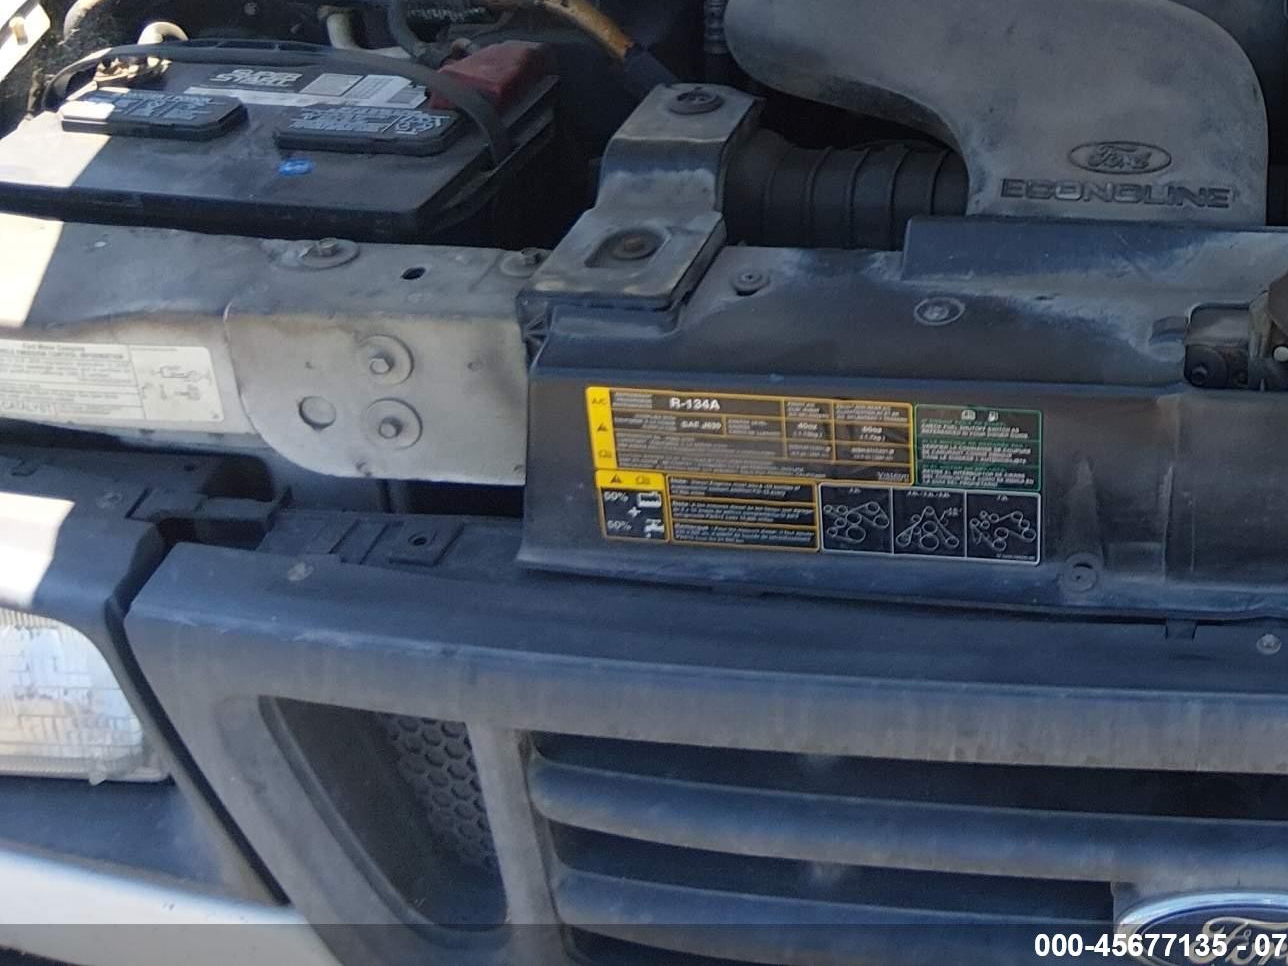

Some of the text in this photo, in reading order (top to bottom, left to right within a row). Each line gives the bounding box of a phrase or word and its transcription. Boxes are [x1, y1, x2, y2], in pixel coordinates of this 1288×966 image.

[1087, 144, 1153, 170] Ford
[1000, 177, 1231, 209] ECONOLINE
[669, 397, 721, 411] R-134A
